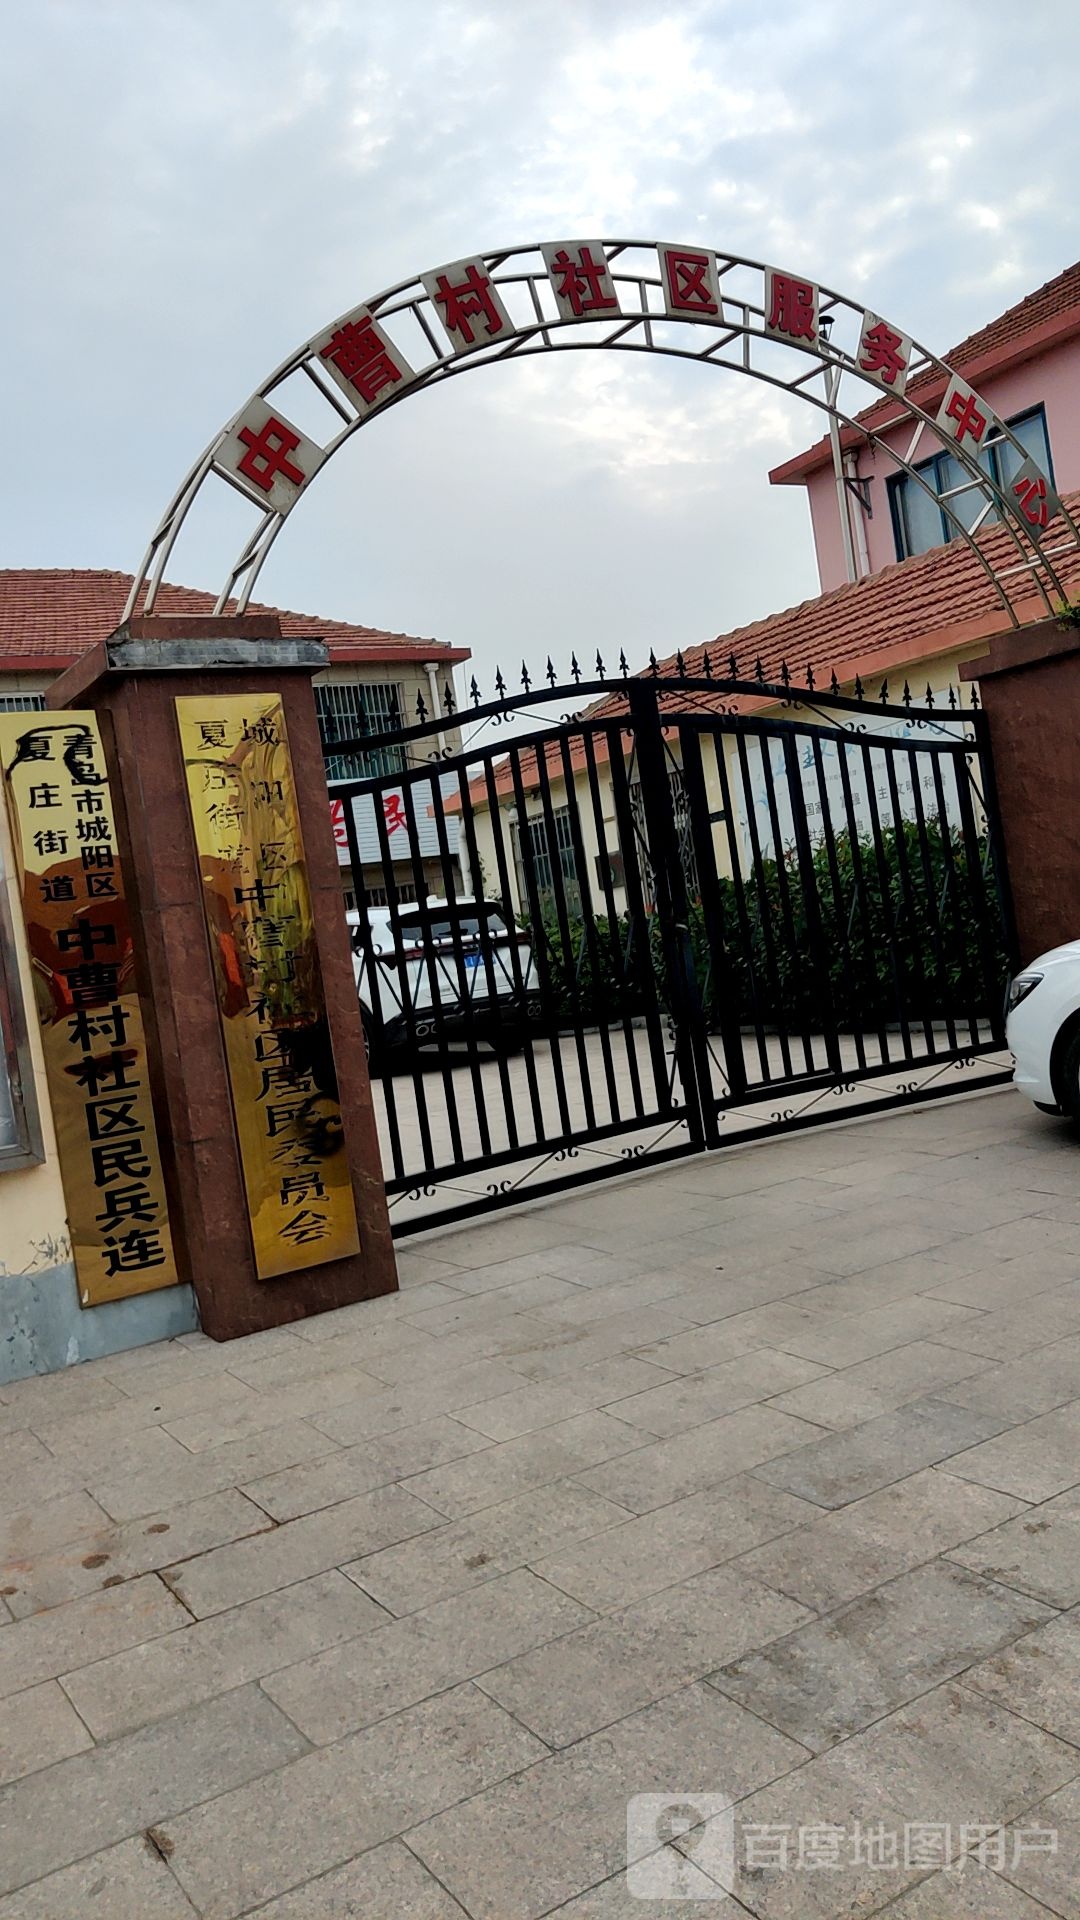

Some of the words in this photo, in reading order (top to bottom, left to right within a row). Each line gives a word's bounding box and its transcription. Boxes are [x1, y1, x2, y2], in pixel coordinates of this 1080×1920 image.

[237, 248, 1051, 527] 中曹村社区服务中心
[24, 735, 77, 903] 夏庄街道
[63, 734, 119, 898] 青岛市城阳区
[56, 918, 166, 1278] 中曹村社区民兵连
